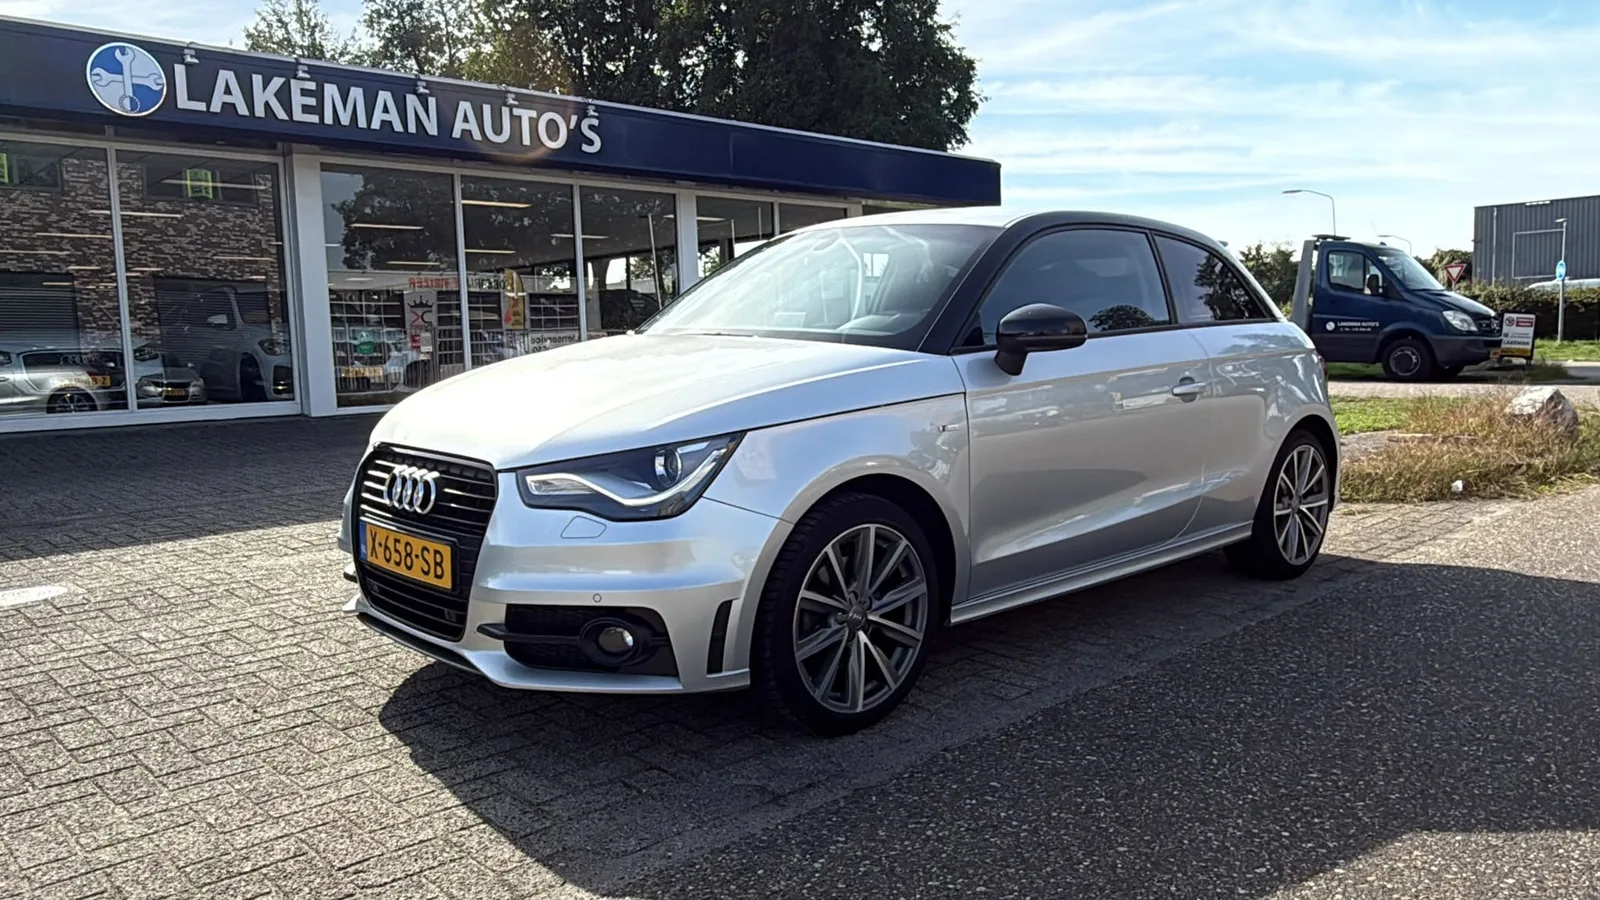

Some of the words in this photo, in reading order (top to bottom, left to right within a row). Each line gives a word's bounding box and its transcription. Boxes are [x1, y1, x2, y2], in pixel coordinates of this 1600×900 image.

[174, 63, 438, 136] LAKEMAN
[451, 100, 602, 153] AUTO'S
[370, 529, 444, 579] X-658-SB
